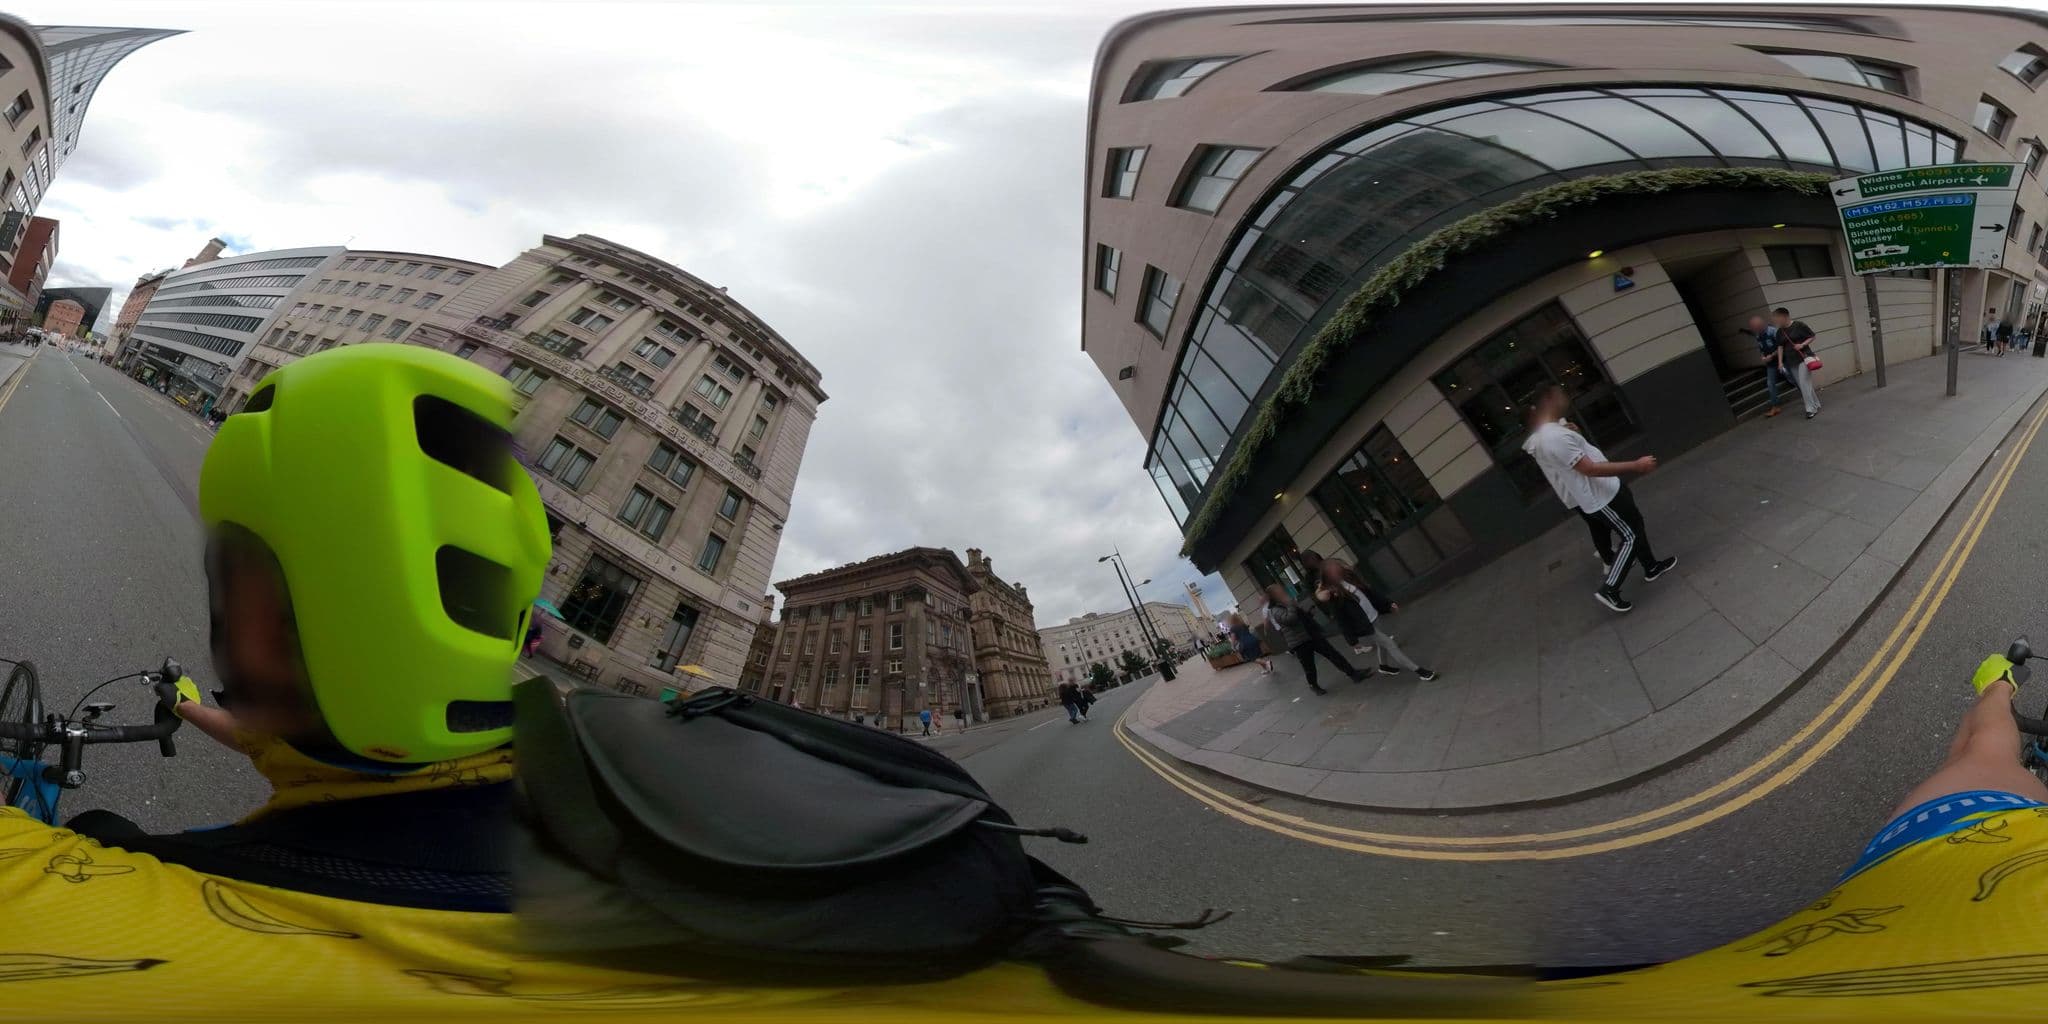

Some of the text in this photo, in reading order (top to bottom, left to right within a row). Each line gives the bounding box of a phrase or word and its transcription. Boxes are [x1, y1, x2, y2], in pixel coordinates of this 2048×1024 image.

[1861, 174, 1902, 185] Widnes
[1863, 177, 1966, 194] Liverpool Airport
[1848, 218, 1880, 229] Bootle
[1851, 224, 1904, 238] Birkenhead
[1852, 233, 1893, 246] Wallasey
